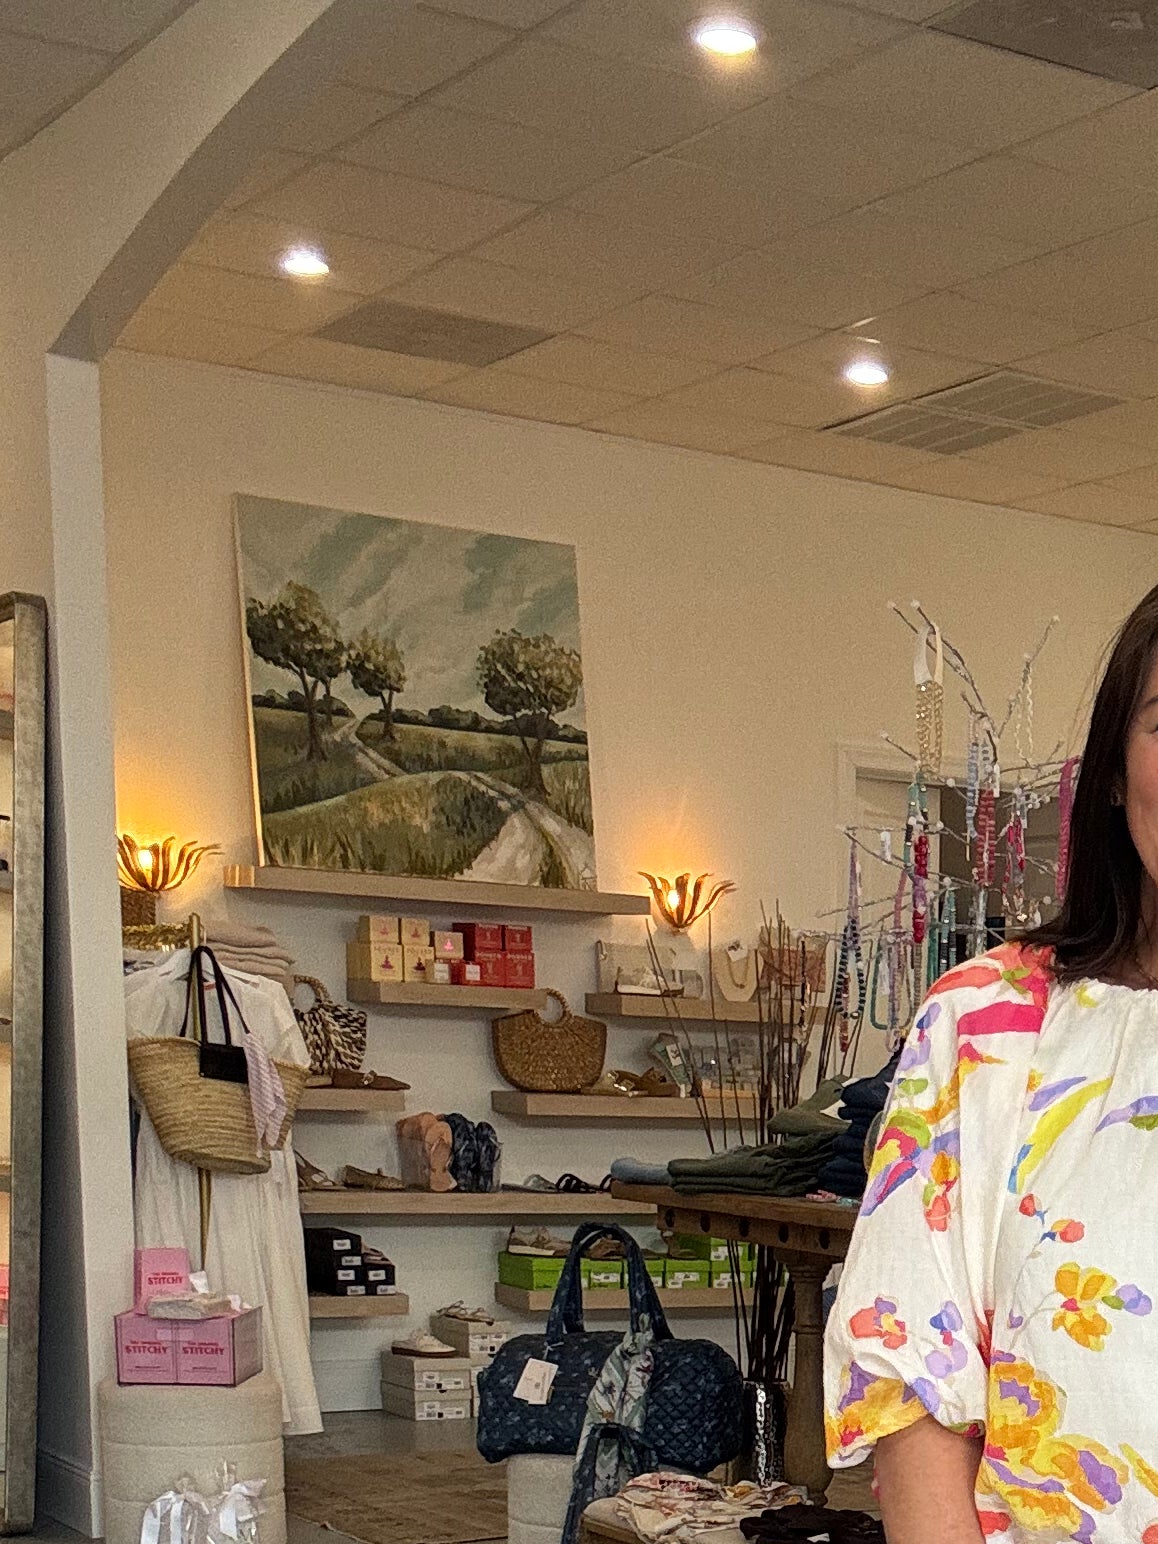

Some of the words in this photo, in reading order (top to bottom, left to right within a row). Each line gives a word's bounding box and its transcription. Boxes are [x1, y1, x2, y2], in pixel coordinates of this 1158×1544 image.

[148, 1276, 183, 1285] STITCHY
[125, 1345, 168, 1354] STITCHY
[182, 1346, 225, 1355] STITCHY
